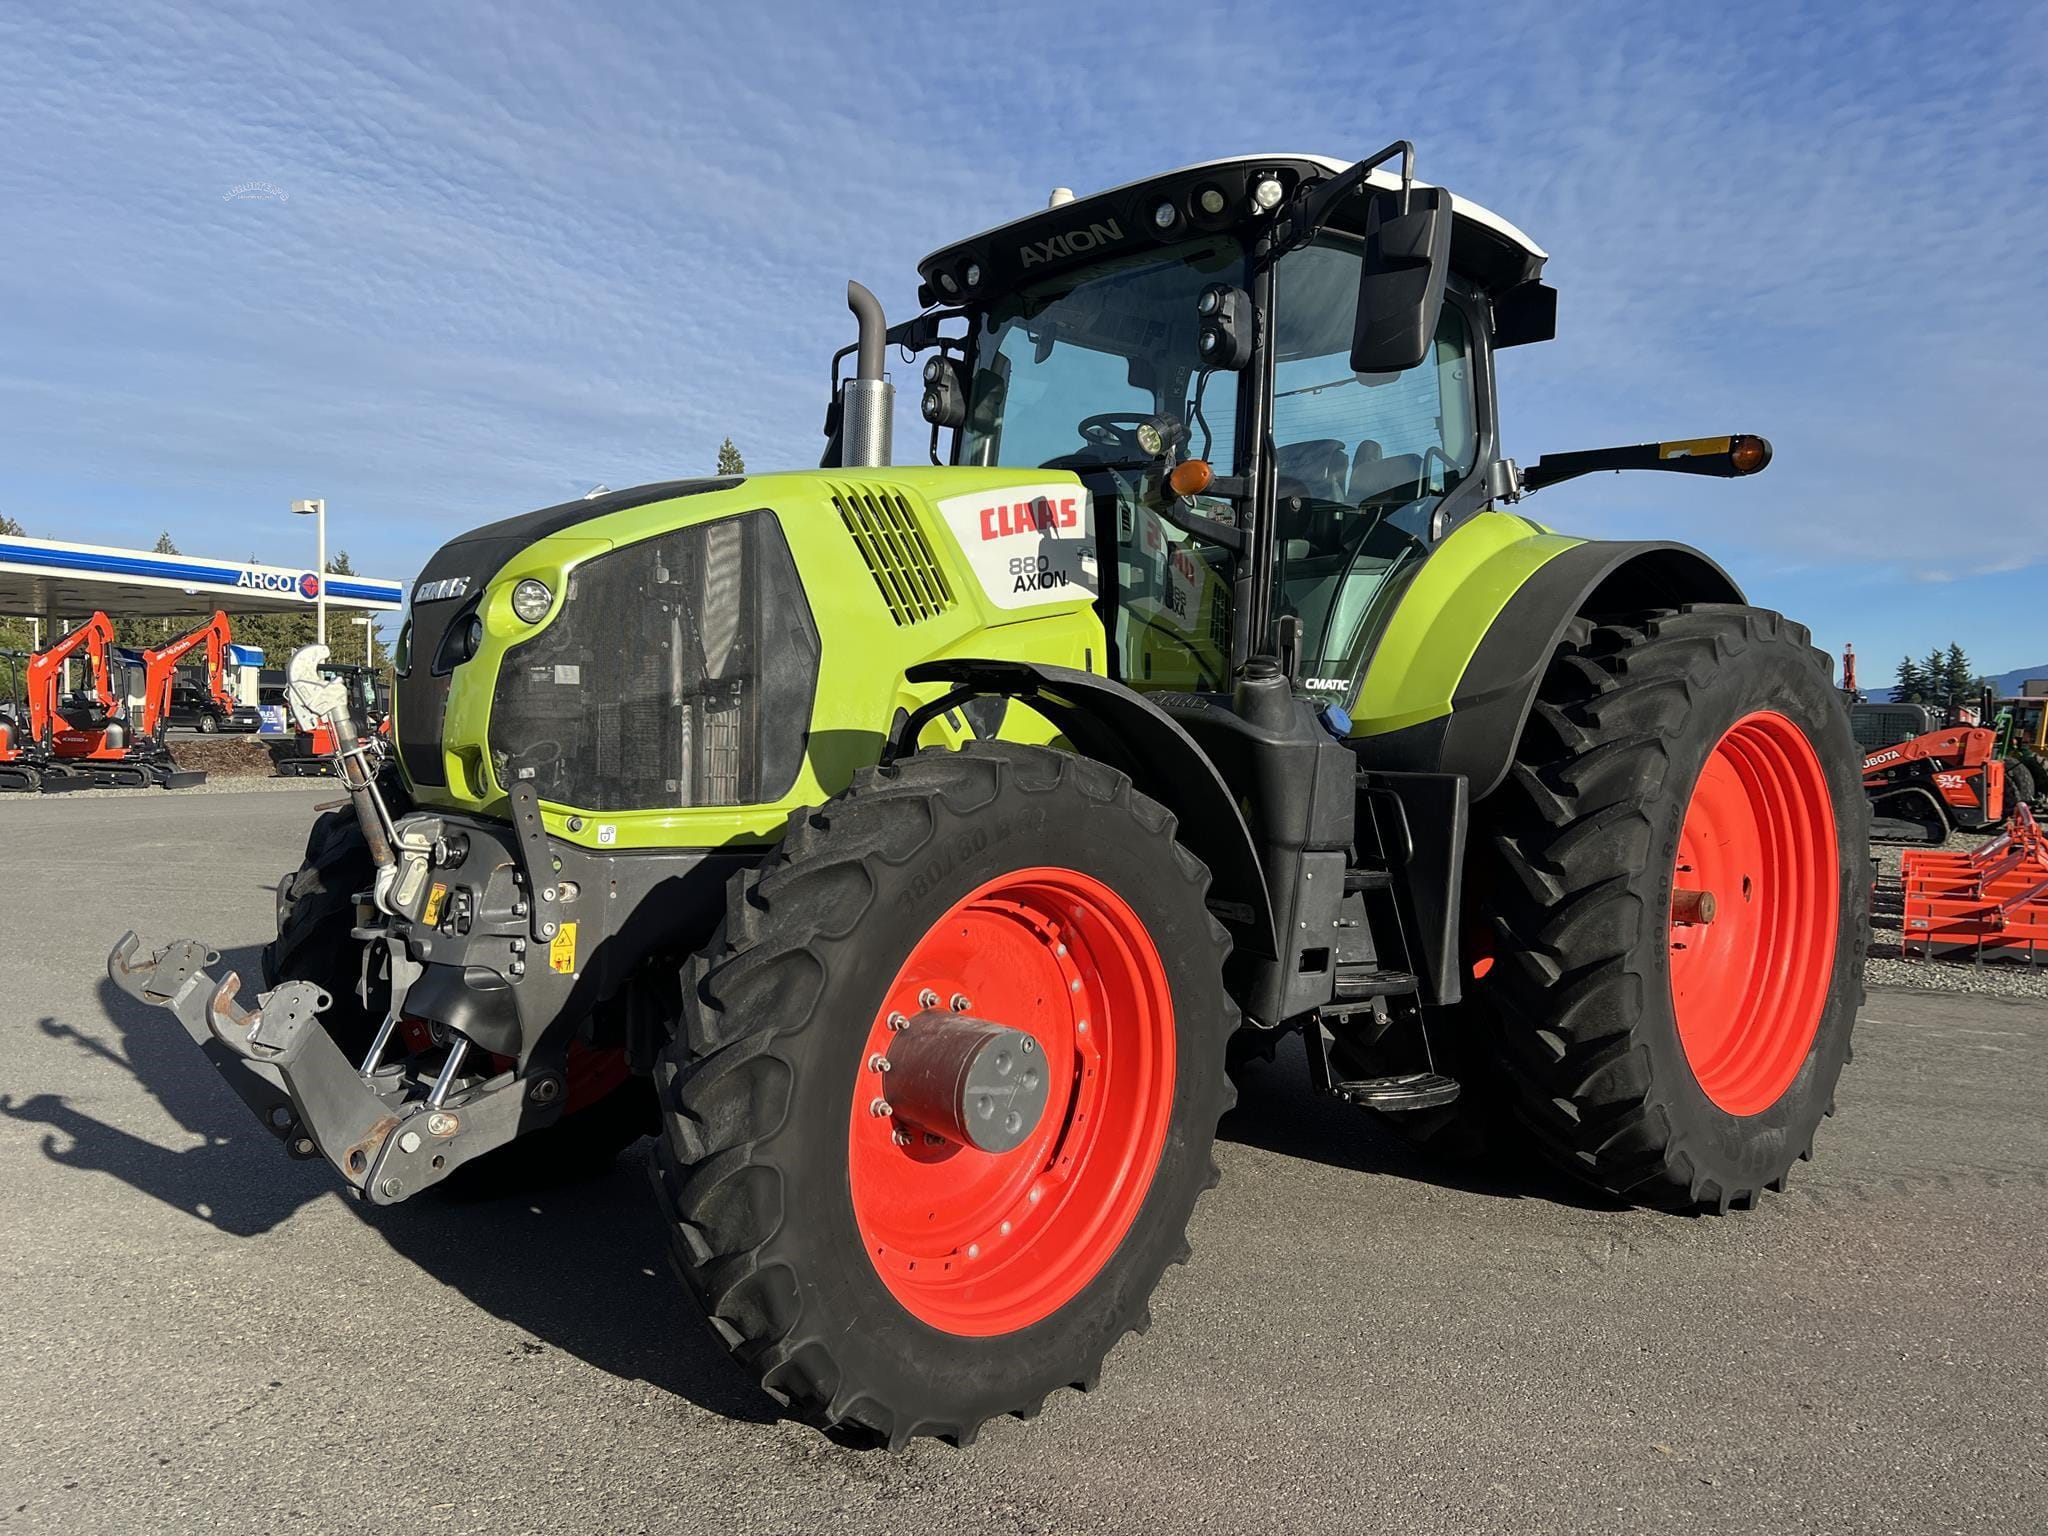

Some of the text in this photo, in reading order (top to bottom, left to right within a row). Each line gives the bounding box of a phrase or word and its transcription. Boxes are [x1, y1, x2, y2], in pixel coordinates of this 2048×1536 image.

[1020, 218, 1124, 268] AXION
[979, 498, 1077, 541] CLAAS
[1009, 555, 1049, 576] 880
[237, 570, 292, 592] ARCO
[1013, 570, 1067, 593] AXION
[1305, 678, 1350, 691] CMATIC
[1862, 750, 1901, 769] UBOTA
